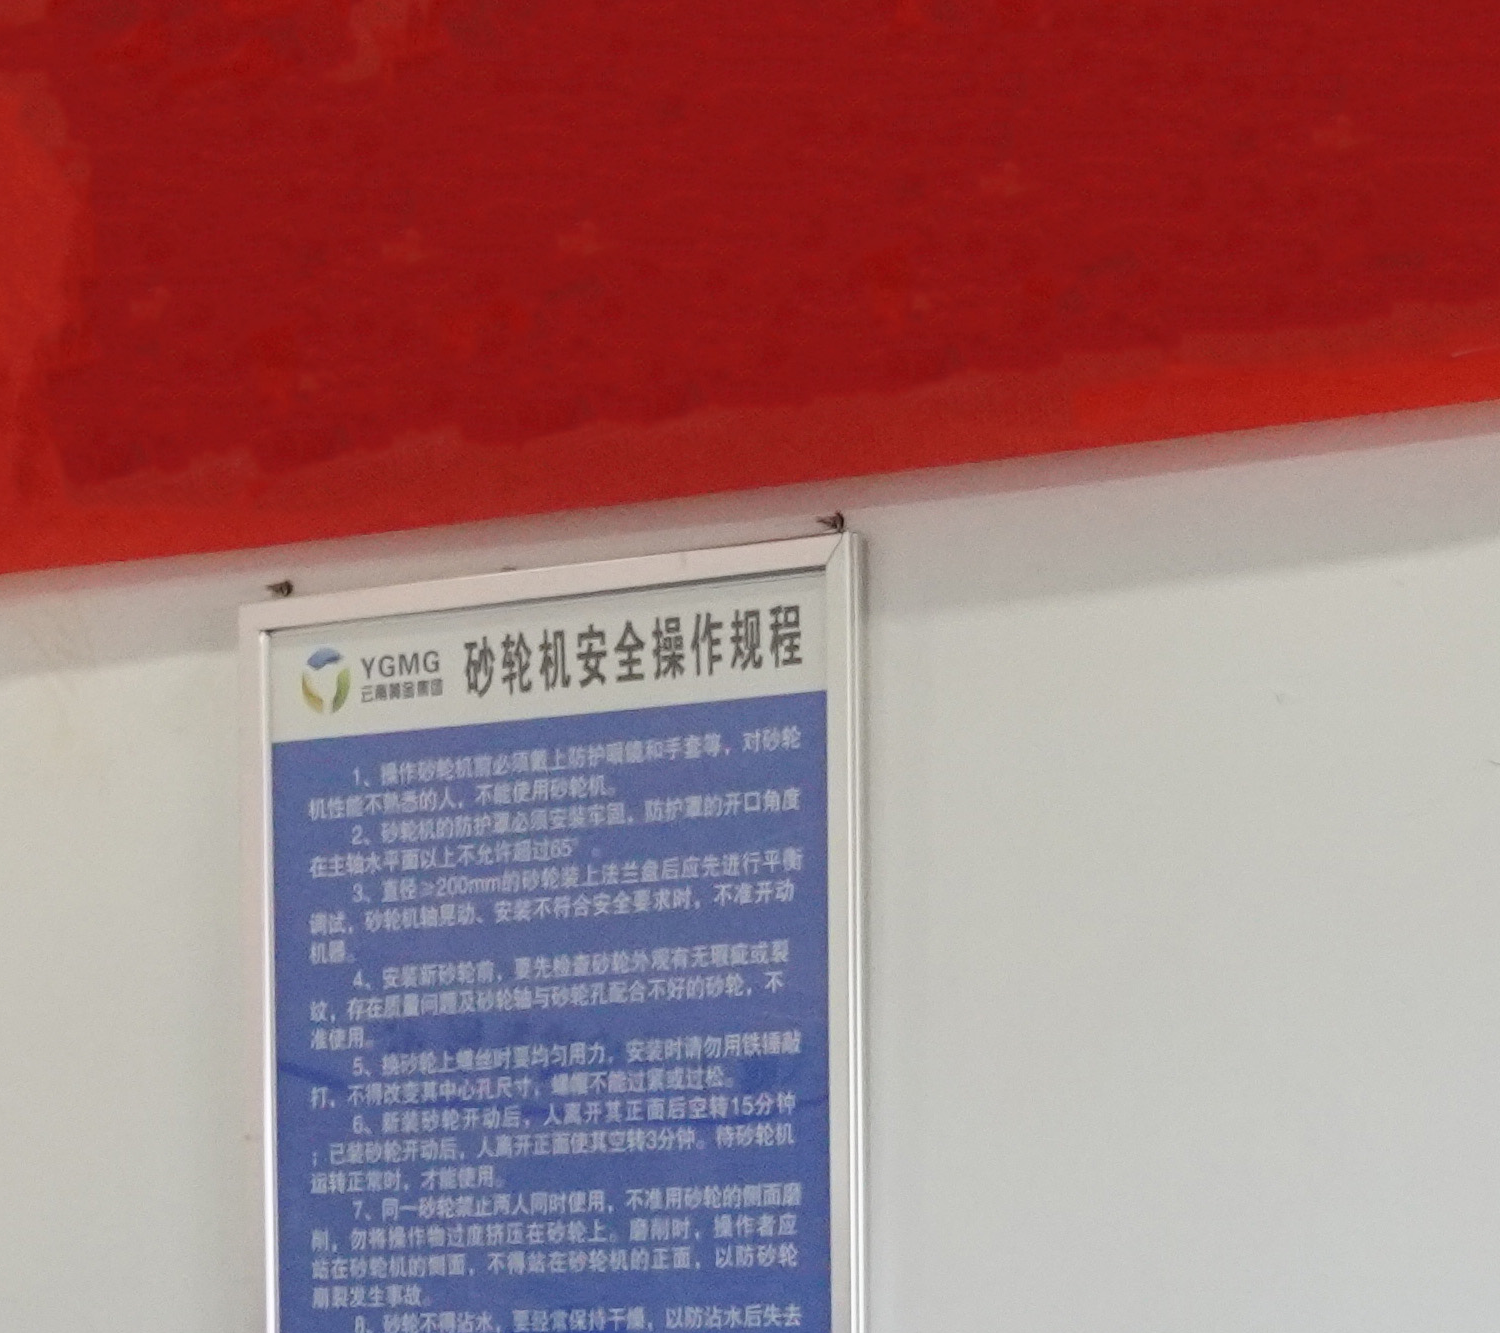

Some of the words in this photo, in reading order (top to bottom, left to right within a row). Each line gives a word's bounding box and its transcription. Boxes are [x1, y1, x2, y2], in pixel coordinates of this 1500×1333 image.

[360, 650, 441, 680] YGMG
[464, 604, 804, 698] 砂轮机安全操作规程
